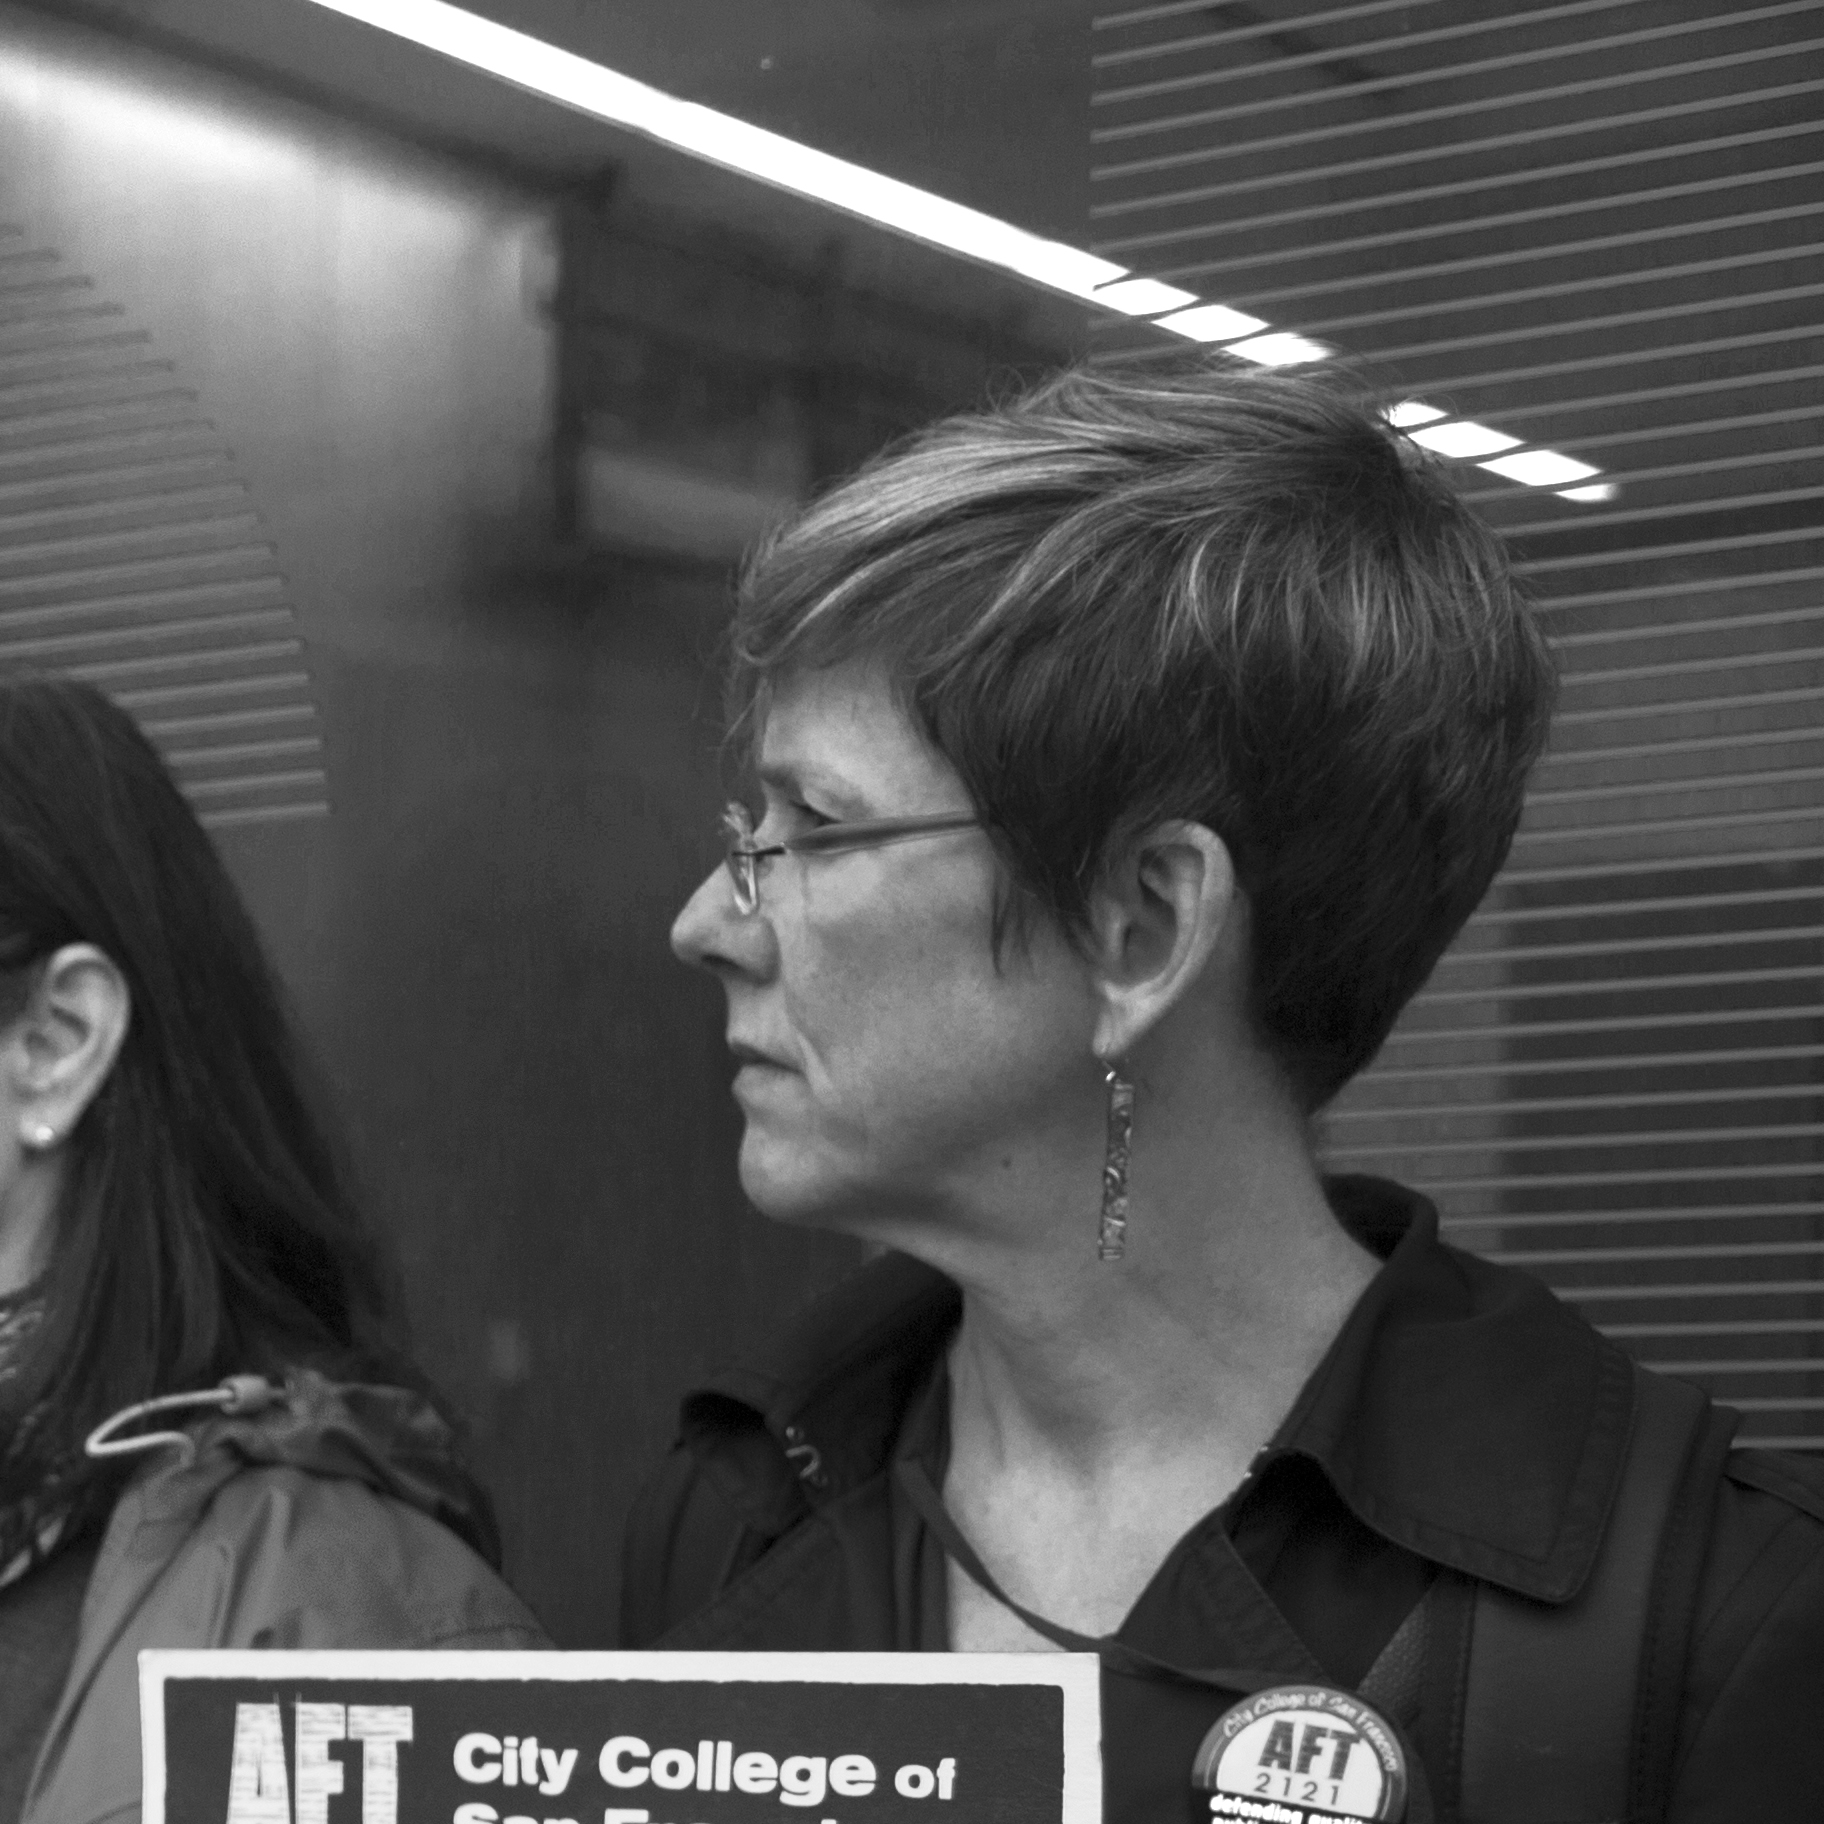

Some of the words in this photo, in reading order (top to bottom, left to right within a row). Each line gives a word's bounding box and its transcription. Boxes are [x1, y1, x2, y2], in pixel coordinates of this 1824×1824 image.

[451, 1732, 579, 1796] City
[597, 1735, 878, 1807] College
[893, 1757, 957, 1801] of
[1258, 1719, 1362, 1781] AFT
[1254, 1773, 1341, 1806] 2121
